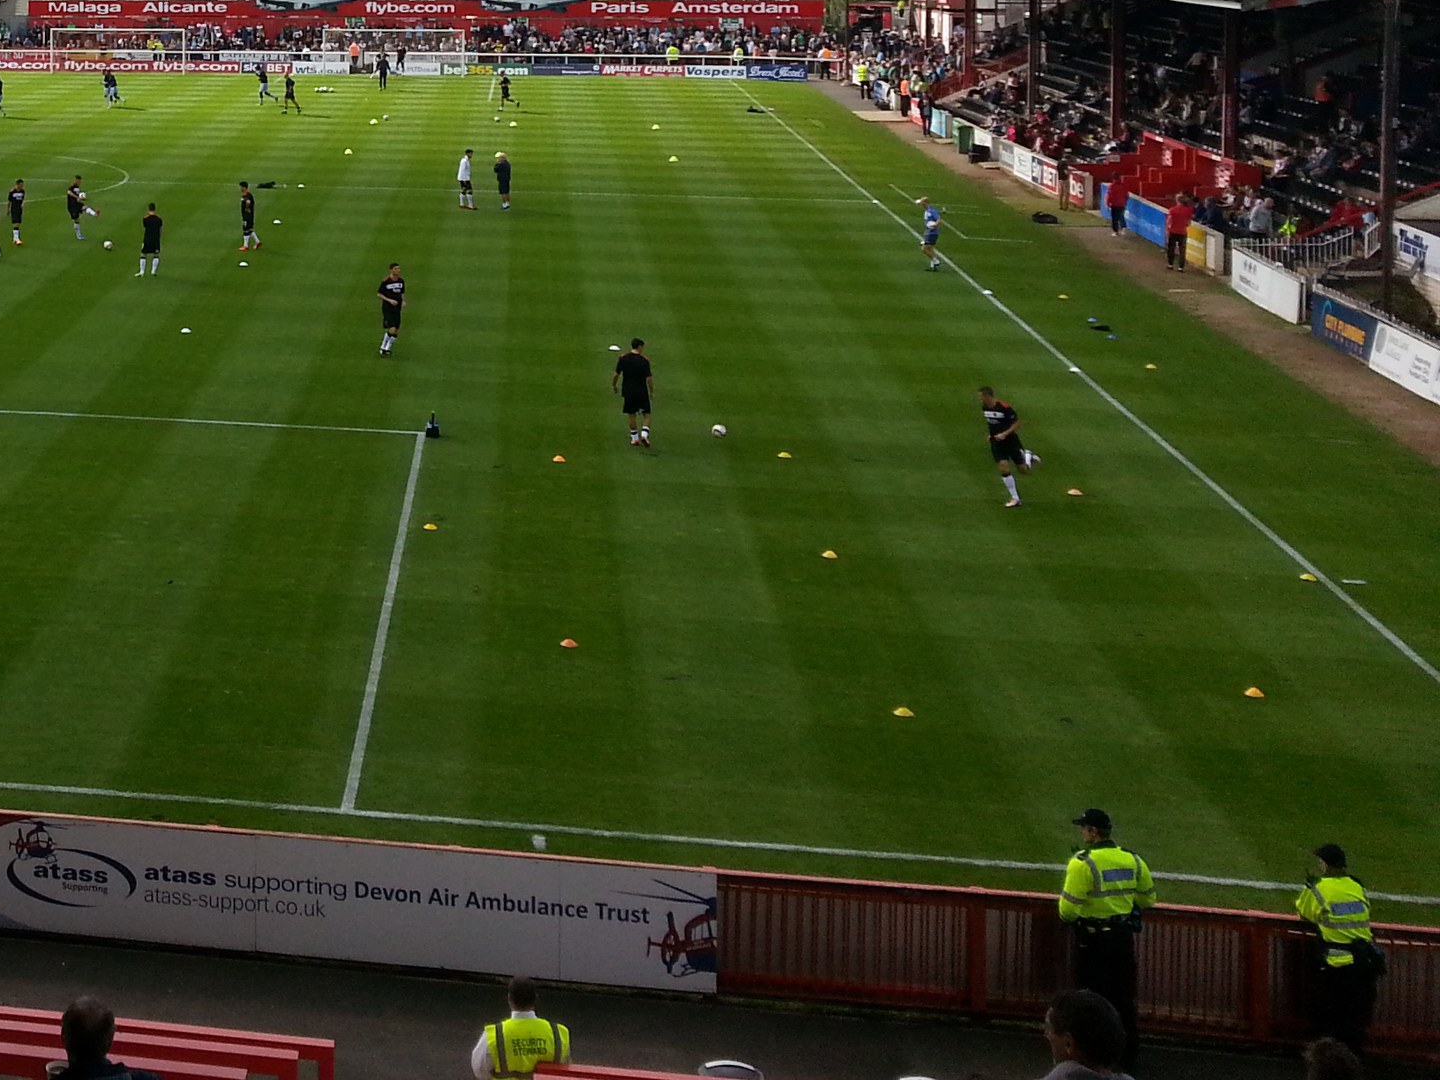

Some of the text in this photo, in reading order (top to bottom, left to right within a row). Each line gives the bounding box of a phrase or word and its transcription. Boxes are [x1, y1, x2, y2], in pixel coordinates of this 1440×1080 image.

[48, 1, 228, 14] Malaga Alicante
[365, 1, 455, 16] flybe.com
[591, 1, 799, 14] Paris Amsterdam
[64, 60, 148, 71] flybe.com
[153, 60, 238, 72] flybe.com
[266, 63, 291, 72] BET
[443, 64, 529, 75] bet365.com
[686, 66, 745, 77] Vospers
[33, 863, 108, 883] atass
[62, 882, 108, 895] Supporting
[144, 865, 650, 924] atass supporting Devon Air Ambulance Trust
[144, 887, 326, 917] atass-support.co.uk
